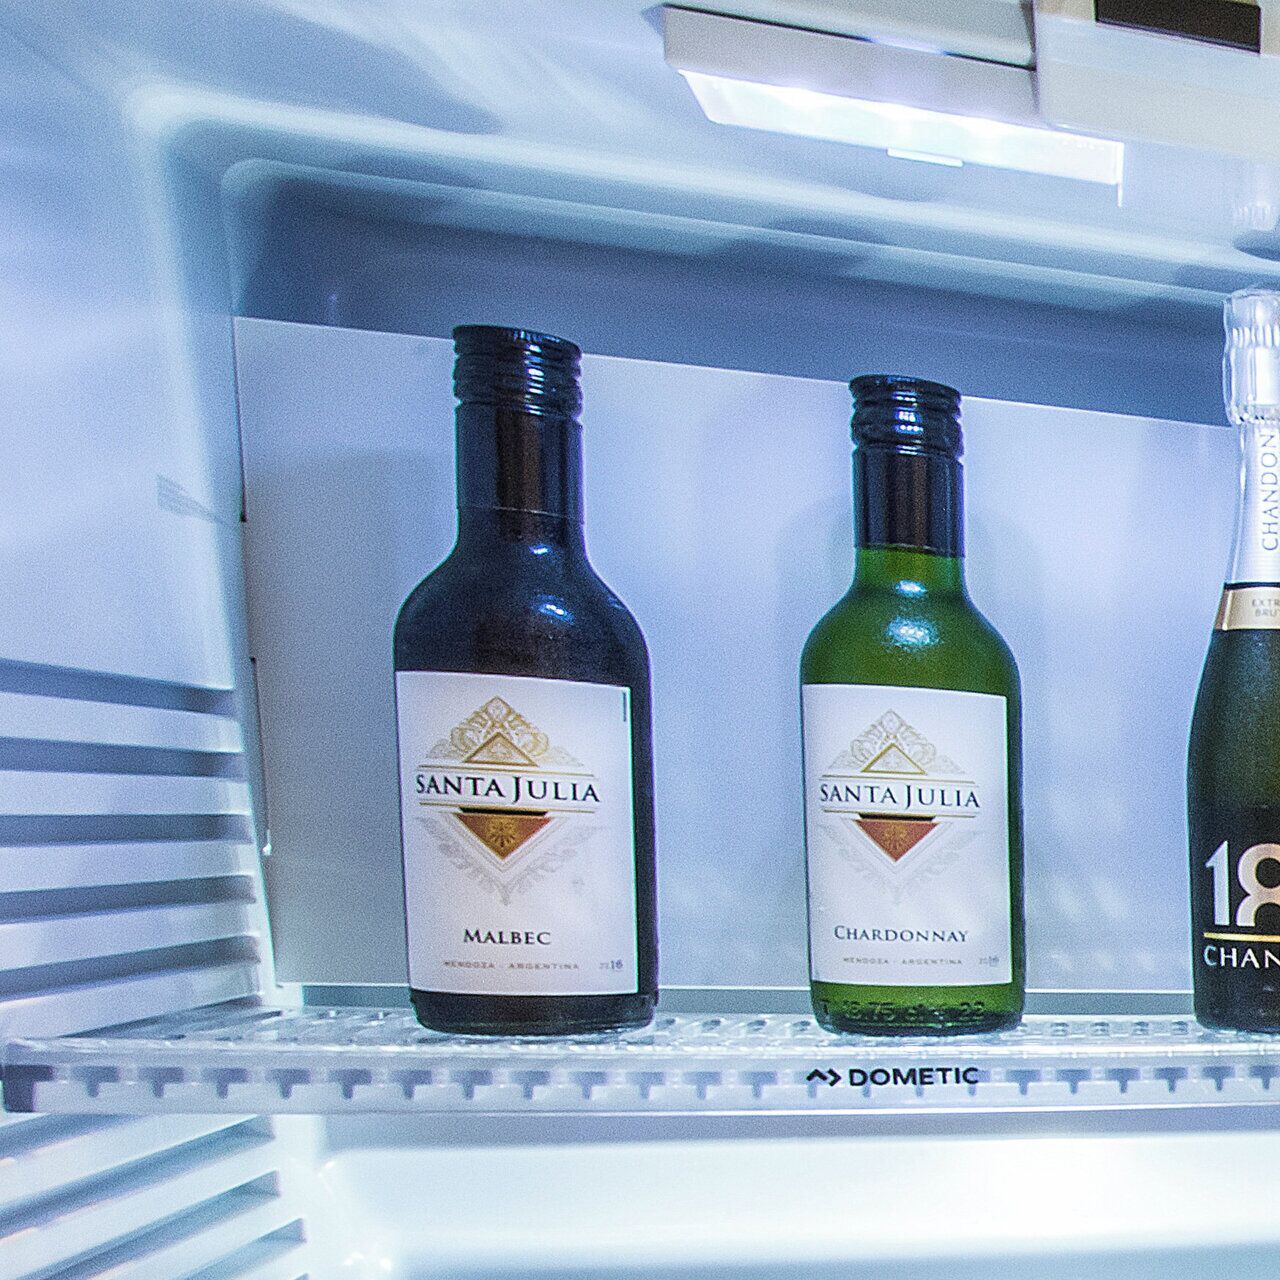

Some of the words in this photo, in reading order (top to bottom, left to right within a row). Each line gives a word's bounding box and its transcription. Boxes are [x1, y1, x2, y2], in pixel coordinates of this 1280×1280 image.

[1259, 433, 1279, 551] CHANDON
[415, 773, 504, 799] SANTA
[509, 775, 601, 805] JULIA
[819, 782, 897, 804] SANTA
[901, 782, 981, 809] JULIA
[463, 928, 552, 946] MALBEC
[833, 925, 969, 943] CHARDONNAY
[850, 1067, 979, 1087] DOMETIC
